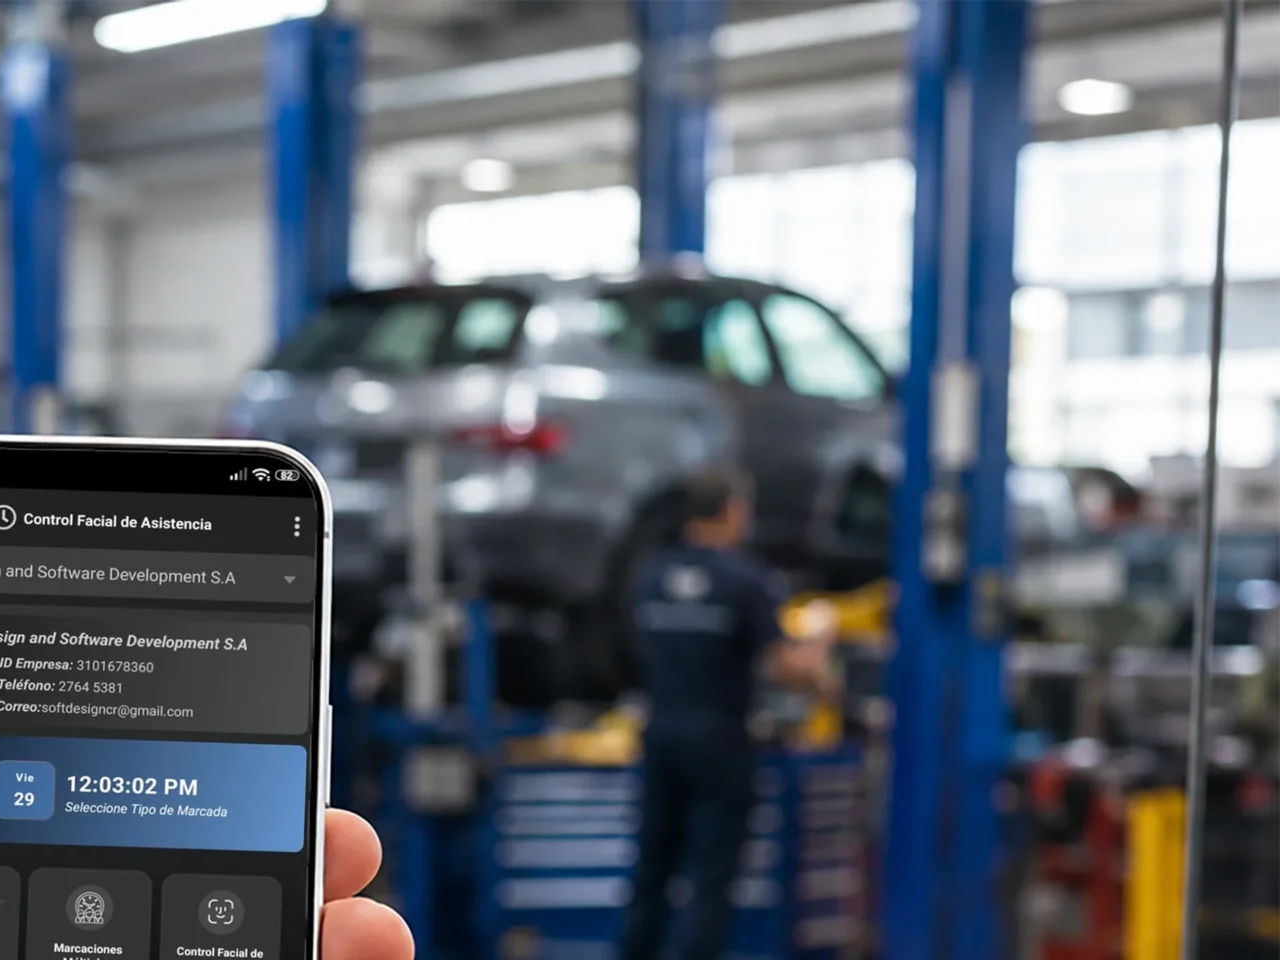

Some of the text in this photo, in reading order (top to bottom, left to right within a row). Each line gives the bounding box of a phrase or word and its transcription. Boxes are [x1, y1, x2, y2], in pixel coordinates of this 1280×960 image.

[281, 470, 293, 480] 82
[24, 513, 211, 530] Control Facial de Asistencia
[6, 565, 33, 578] and
[38, 565, 105, 580] Software
[110, 568, 206, 585] Development
[211, 571, 235, 584] S.A
[29, 632, 56, 644] and
[60, 633, 123, 646] Software
[127, 635, 220, 651] Development
[224, 638, 247, 650] S.A
[0, 657, 154, 673] ID Empresa: 3101678360
[59, 681, 89, 692] 2764
[94, 682, 121, 693] 5381
[16, 773, 34, 782] Vie
[68, 776, 198, 796] 12:03:02 PM
[14, 792, 34, 806] 29
[65, 802, 227, 817] Seleccione Tipo de Marcada
[54, 943, 122, 954] Marcaciones
[177, 947, 263, 958] Control Facial de
